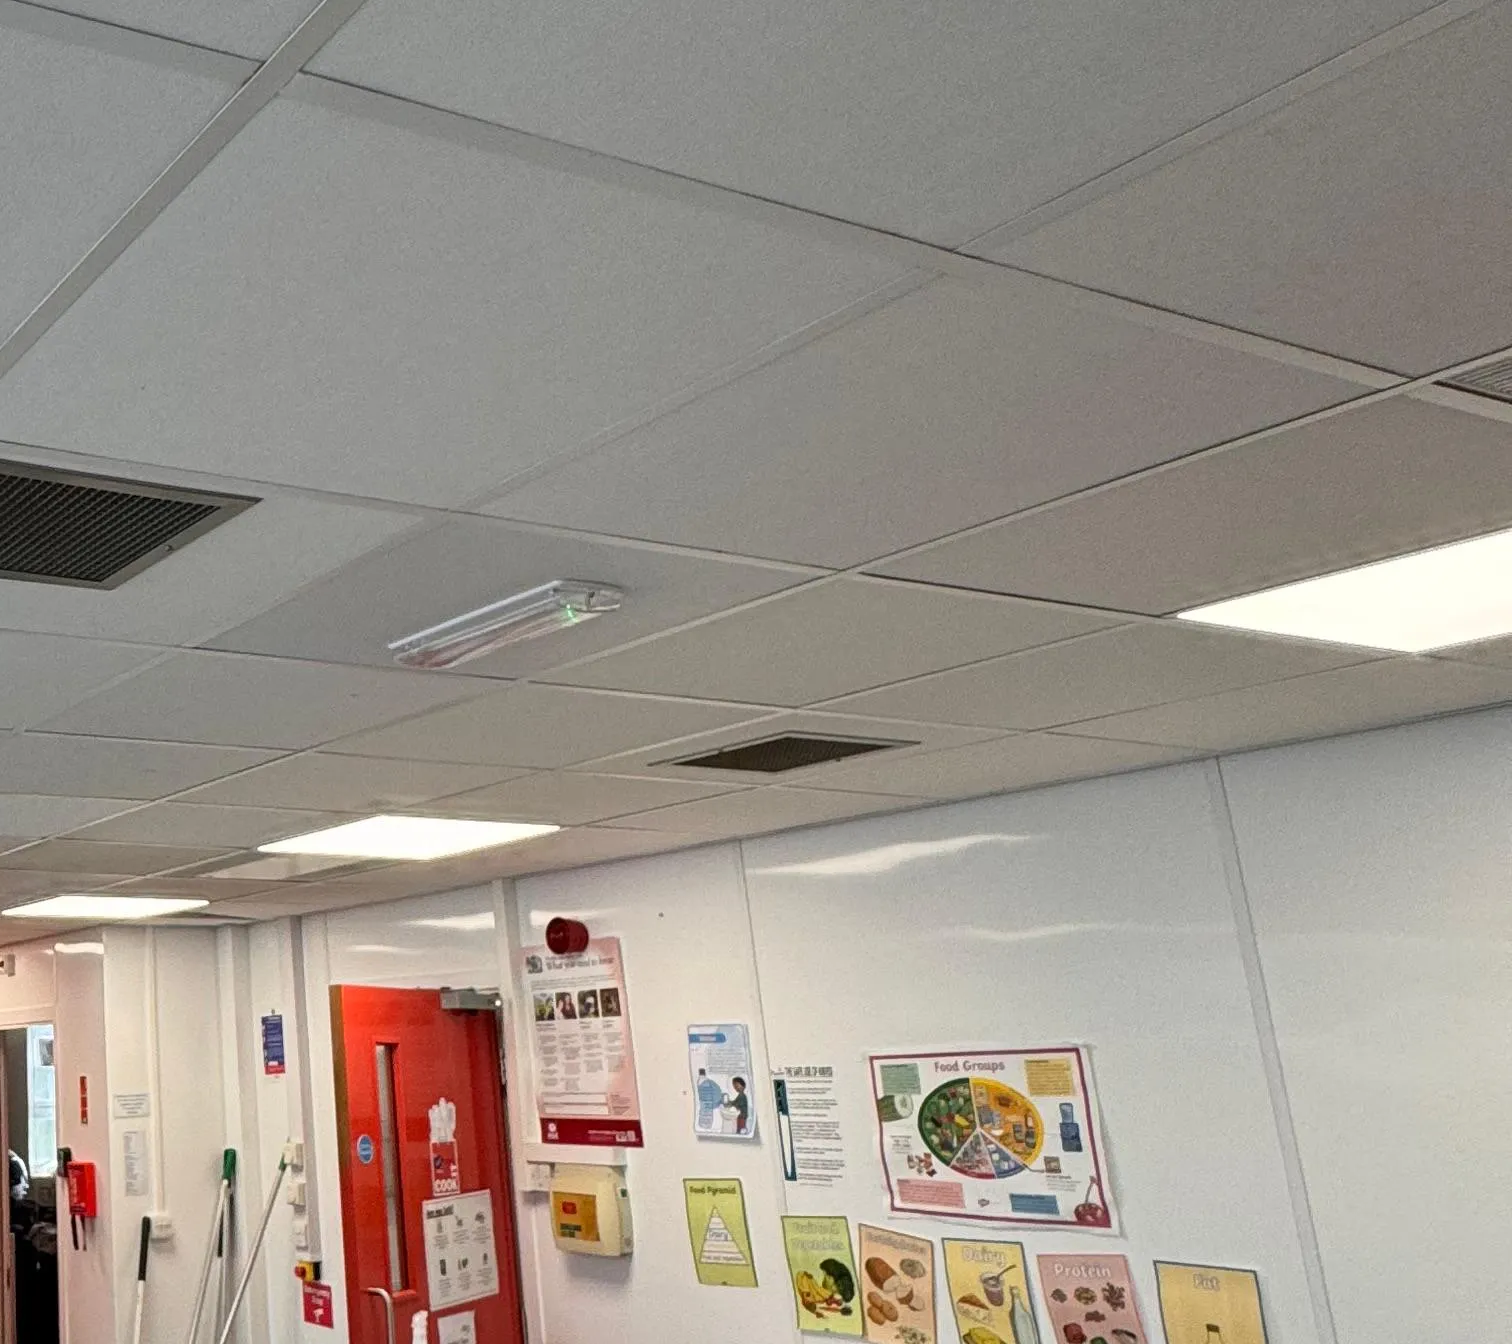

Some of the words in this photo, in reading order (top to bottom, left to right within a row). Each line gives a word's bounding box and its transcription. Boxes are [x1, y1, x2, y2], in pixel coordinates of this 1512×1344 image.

[934, 1060, 959, 1073] Food
[964, 1060, 1005, 1074] Groups
[707, 1185, 736, 1196] Pyramid
[961, 1246, 1008, 1267] Dairy
[1054, 1263, 1112, 1279] Protein
[1192, 1273, 1220, 1291] Fat
